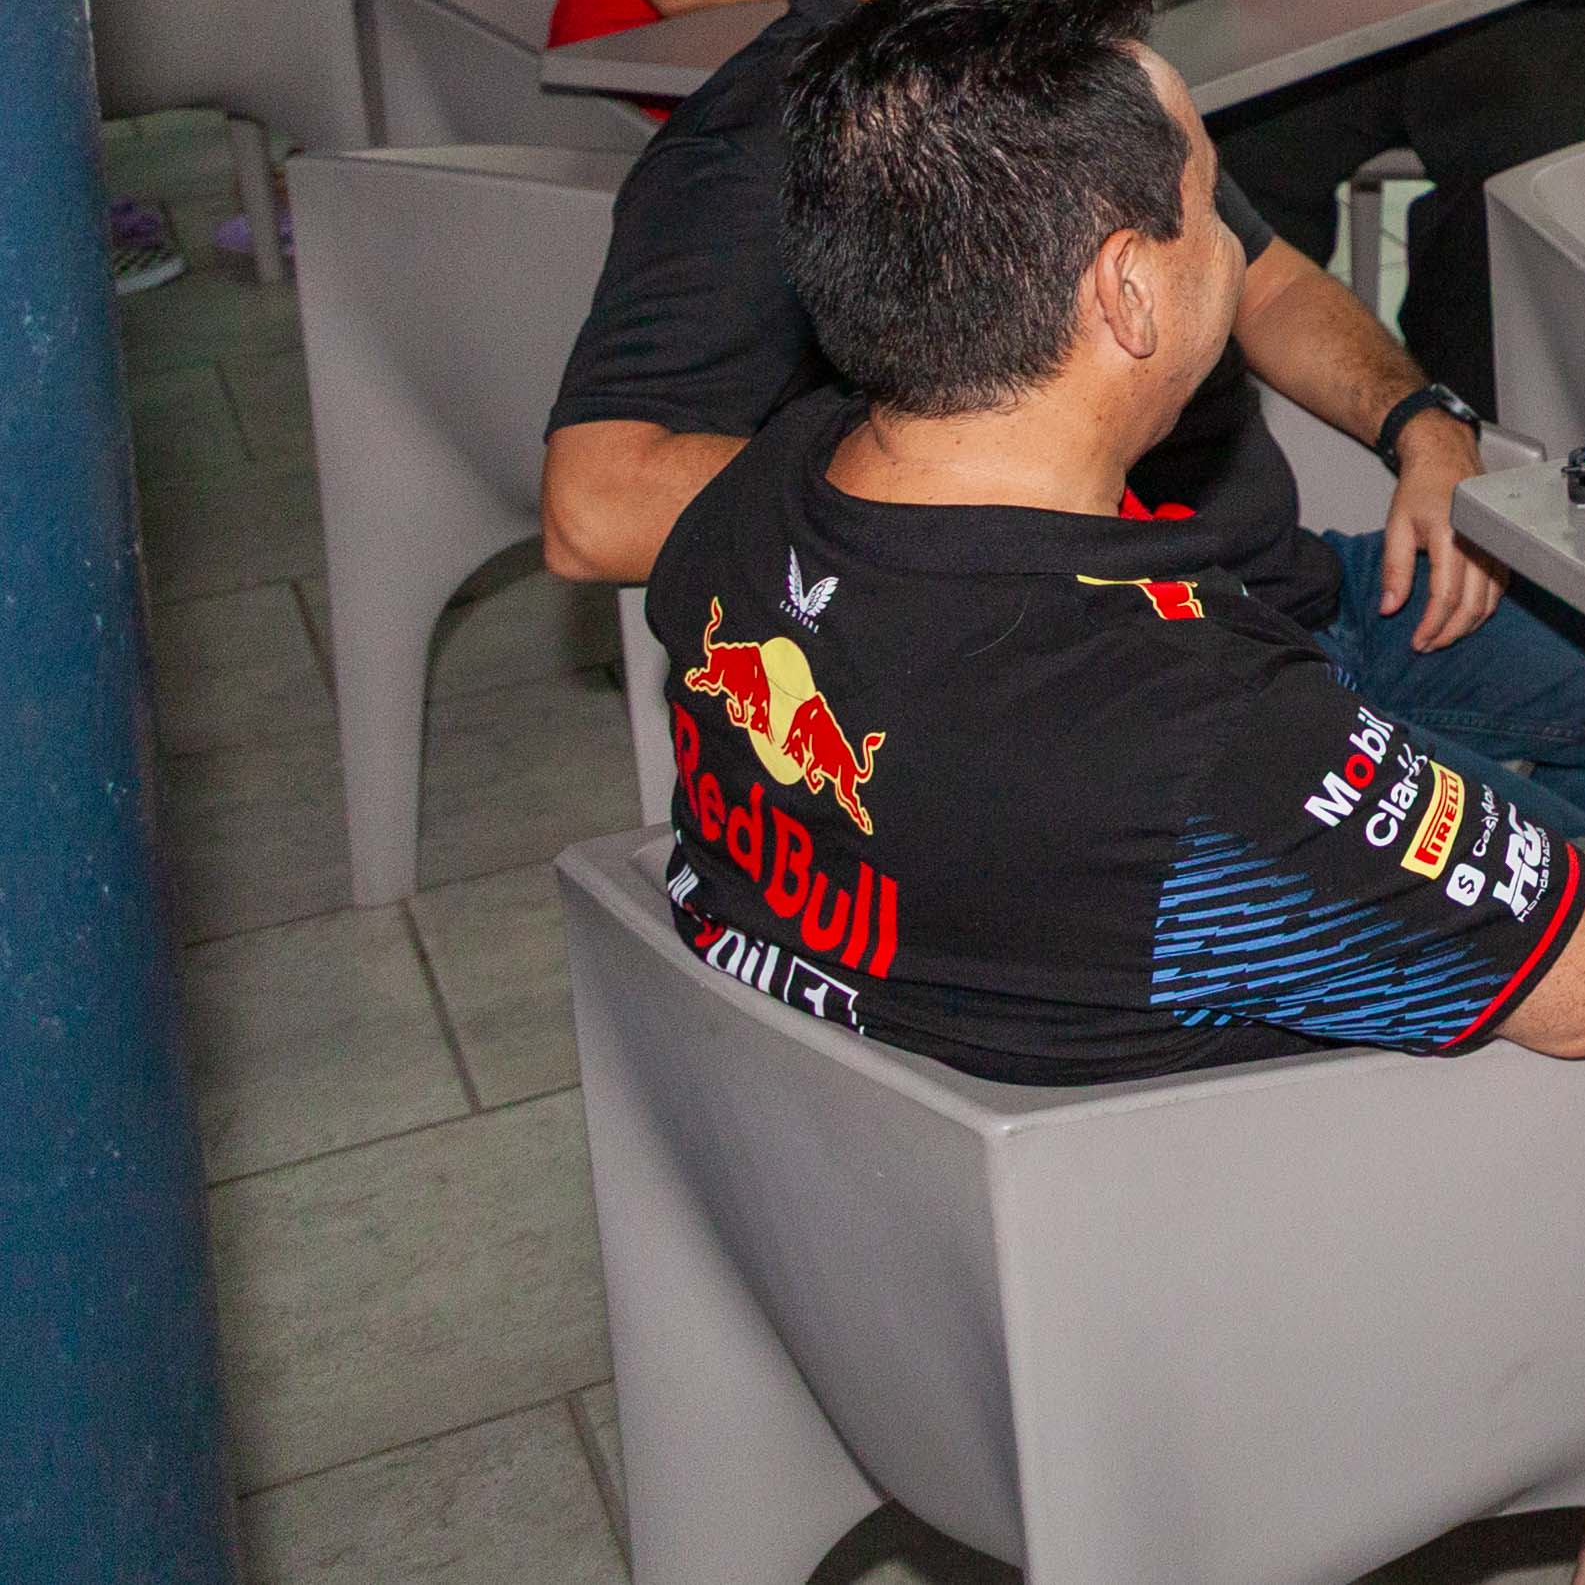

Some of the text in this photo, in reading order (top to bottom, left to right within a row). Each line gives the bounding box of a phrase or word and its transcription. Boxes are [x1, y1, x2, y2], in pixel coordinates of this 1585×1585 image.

[1304, 706, 1394, 827] Mobil
[1414, 769, 1460, 866] PIRELLI
[671, 701, 898, 980] Red Bull
